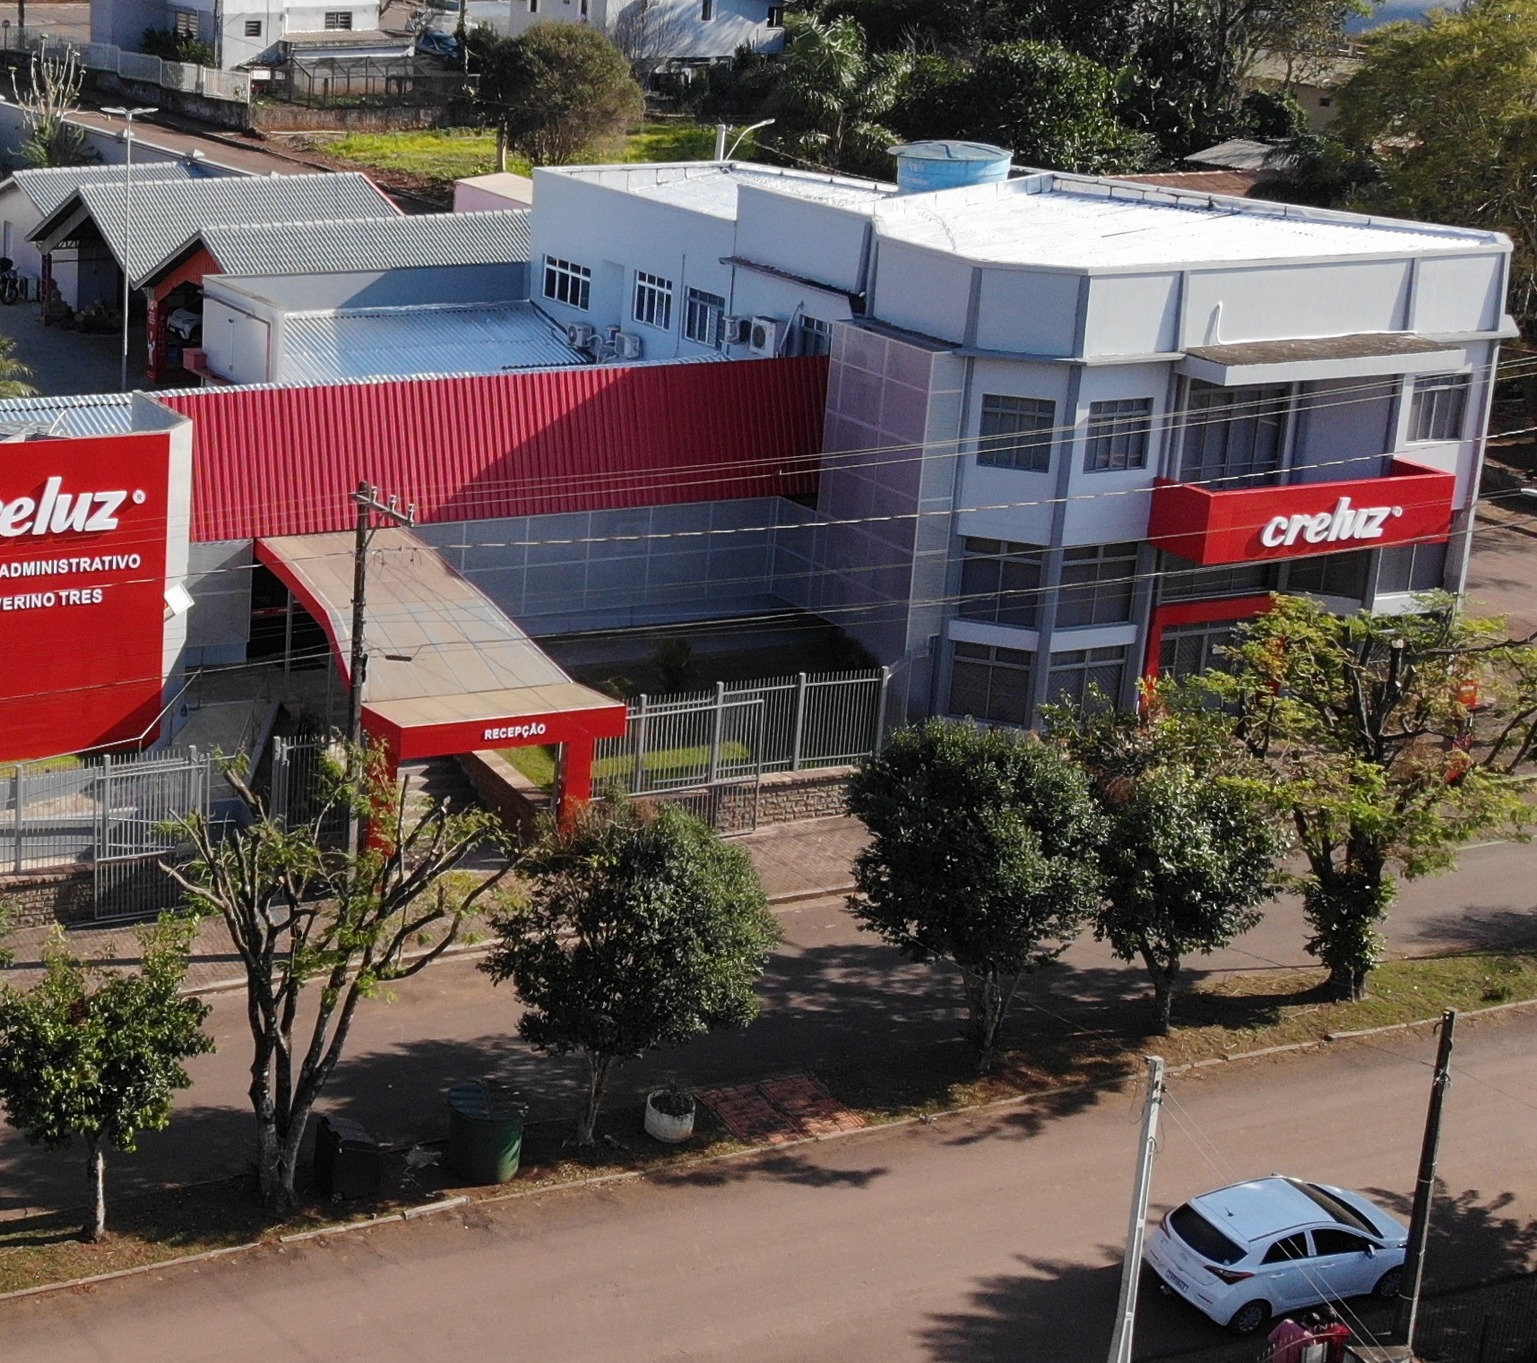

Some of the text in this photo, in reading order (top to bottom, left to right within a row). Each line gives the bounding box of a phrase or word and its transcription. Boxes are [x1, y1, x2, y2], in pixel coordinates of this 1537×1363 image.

[1261, 496, 1392, 547] creluz
[59, 589, 103, 606] TRES
[484, 722, 546, 740] RECEPÇÃO
